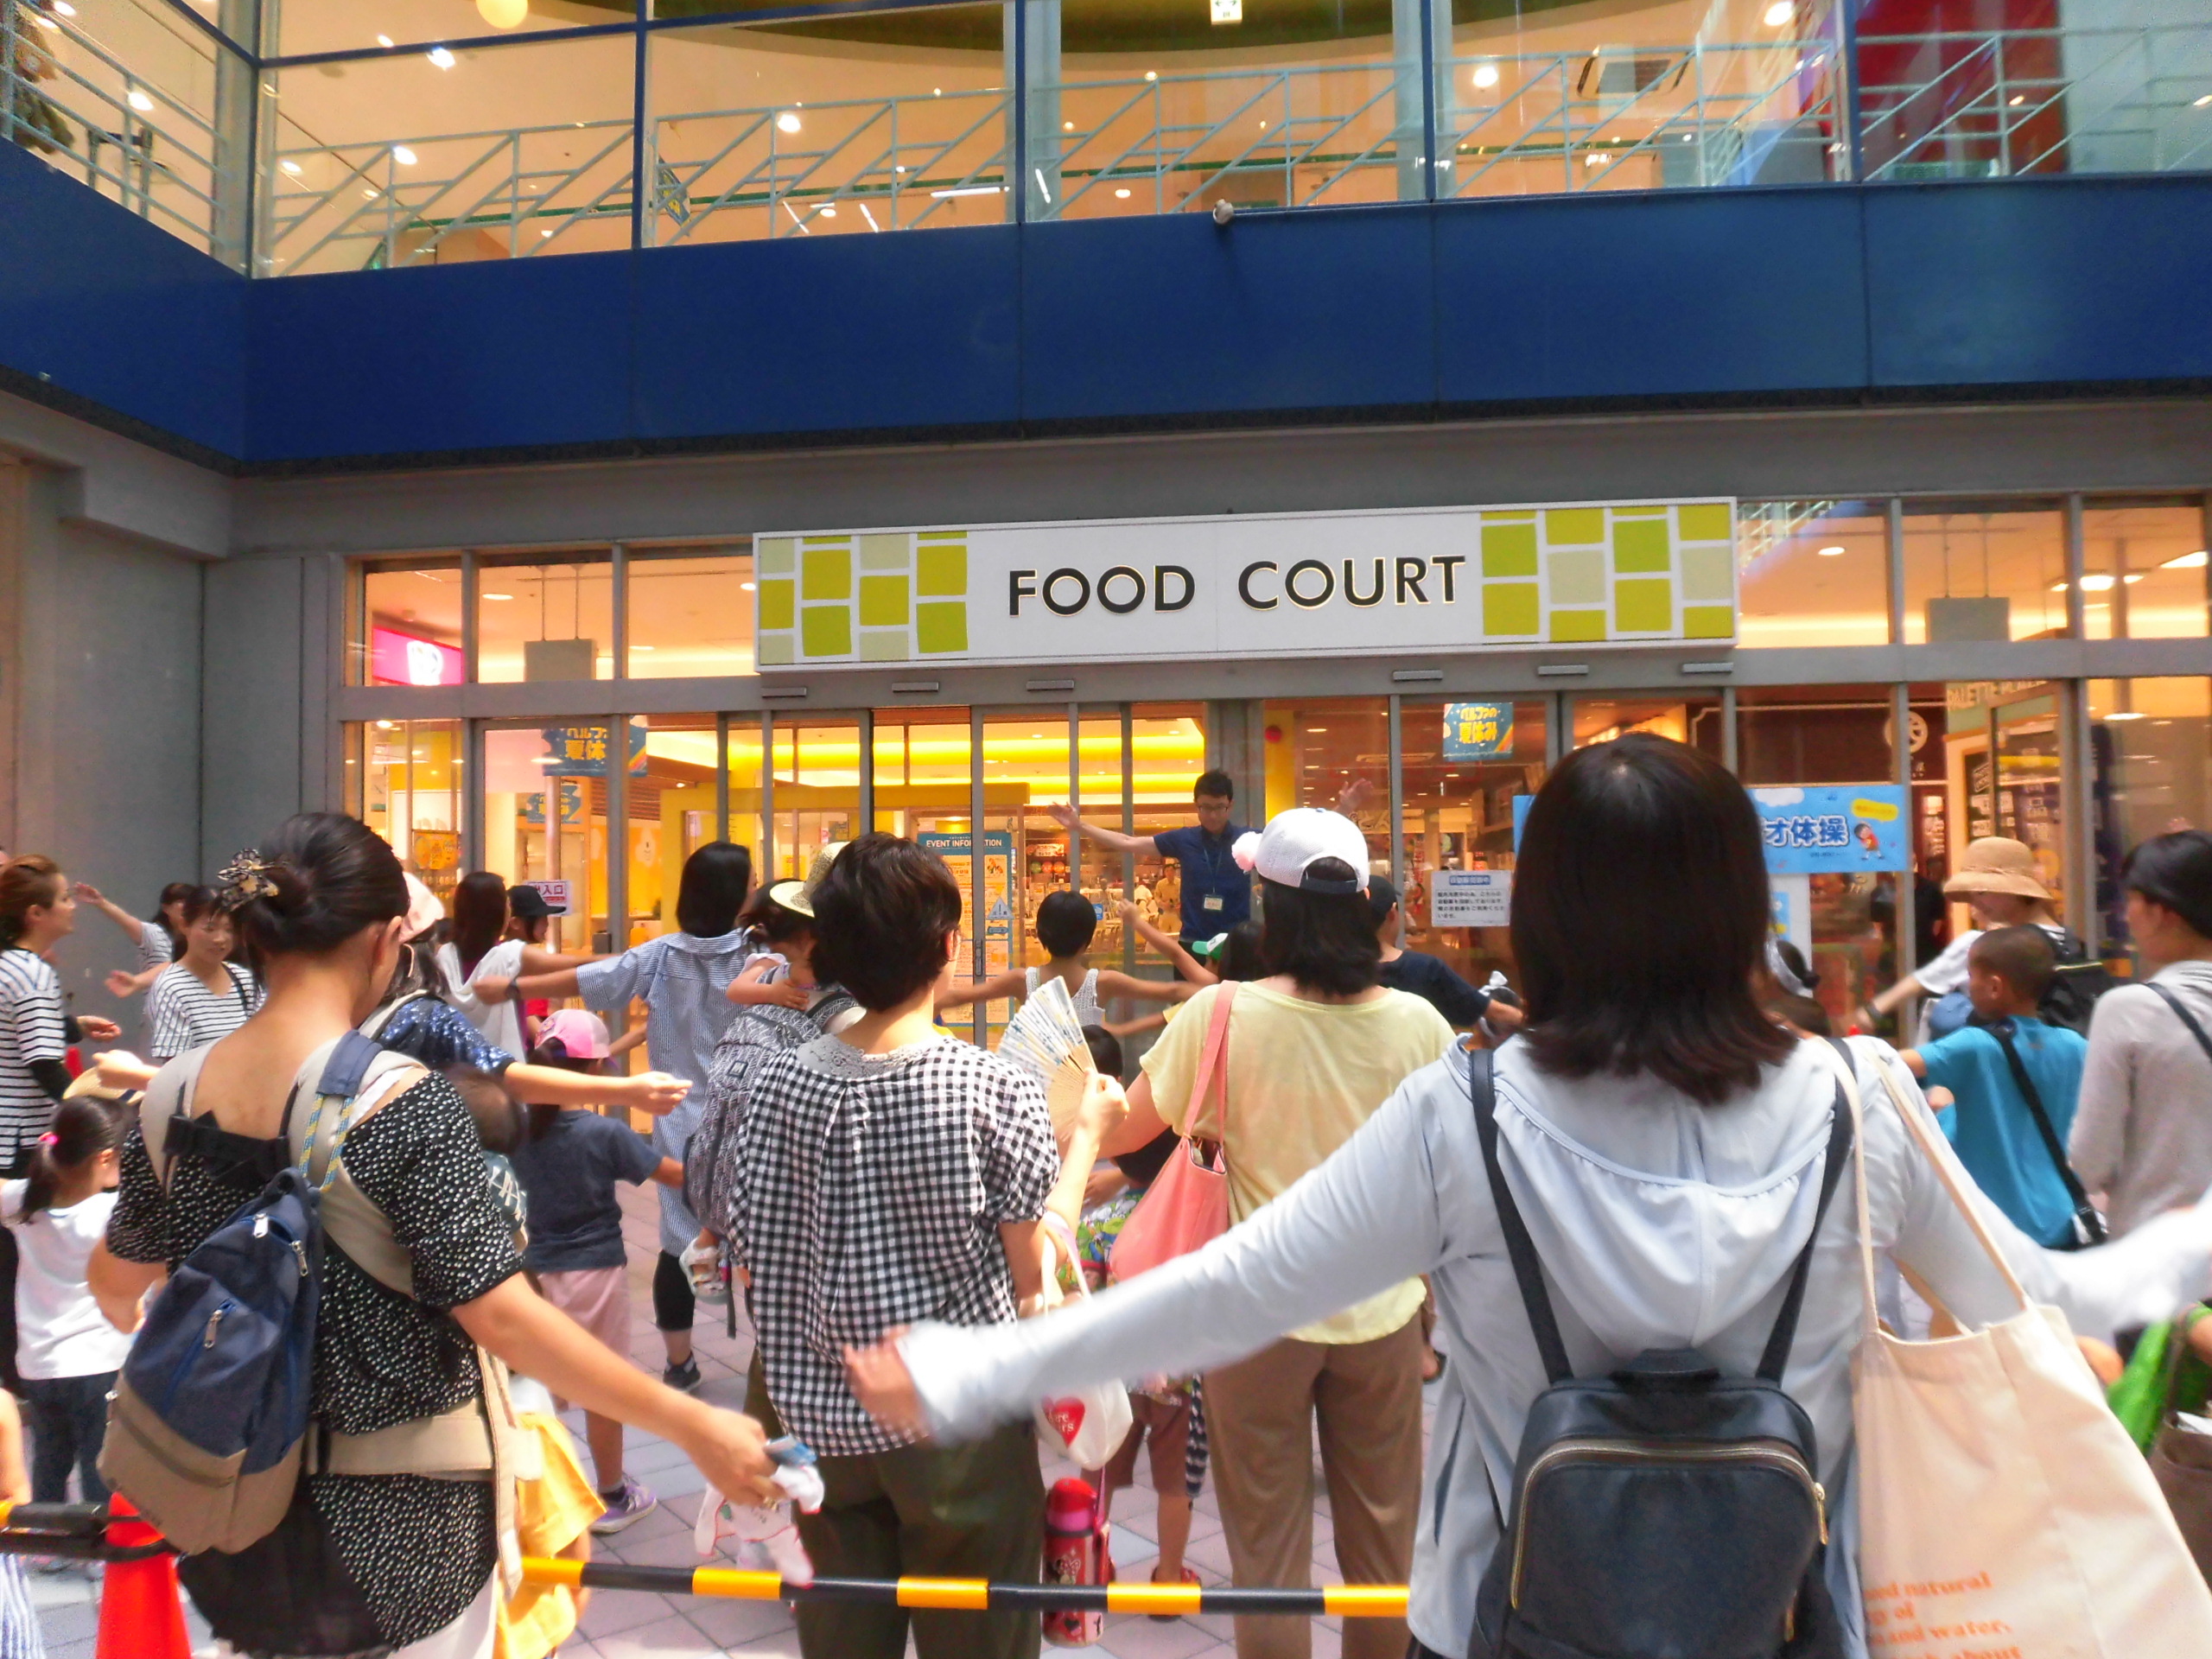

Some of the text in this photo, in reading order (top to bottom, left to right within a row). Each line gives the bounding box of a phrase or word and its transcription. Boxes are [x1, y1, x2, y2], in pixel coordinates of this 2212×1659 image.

[1009, 556, 1465, 617] FOOD COURT
[1459, 721, 1497, 744] 夏休み
[564, 740, 607, 760] 夏休
[952, 838, 1002, 848] INFOTION
[1904, 1571, 1992, 1597] natural
